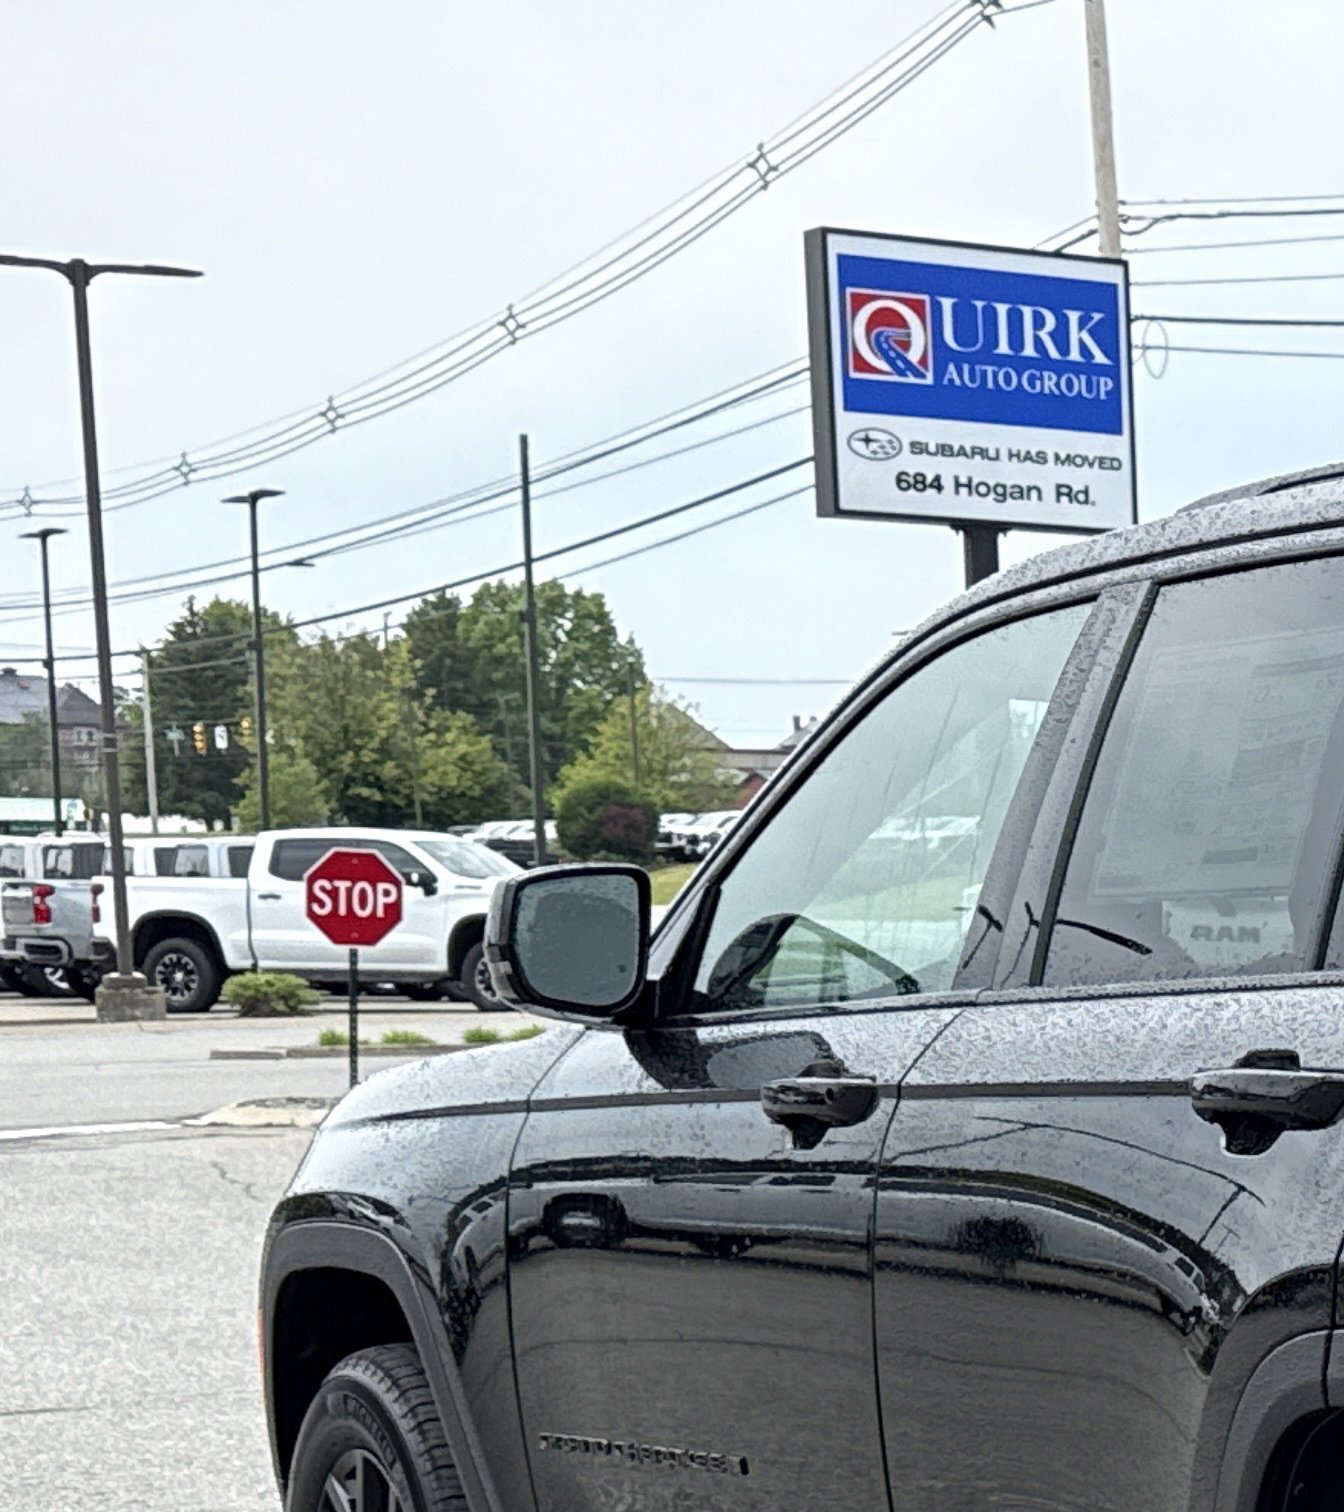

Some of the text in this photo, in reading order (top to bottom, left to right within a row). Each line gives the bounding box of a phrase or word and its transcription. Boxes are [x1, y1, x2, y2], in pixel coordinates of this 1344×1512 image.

[852, 296, 1113, 379] QUIRK
[909, 440, 1122, 471] SUBARU HAS MOVED
[895, 471, 1096, 506] 684 Hogan Rd.
[311, 878, 398, 919] STOP
